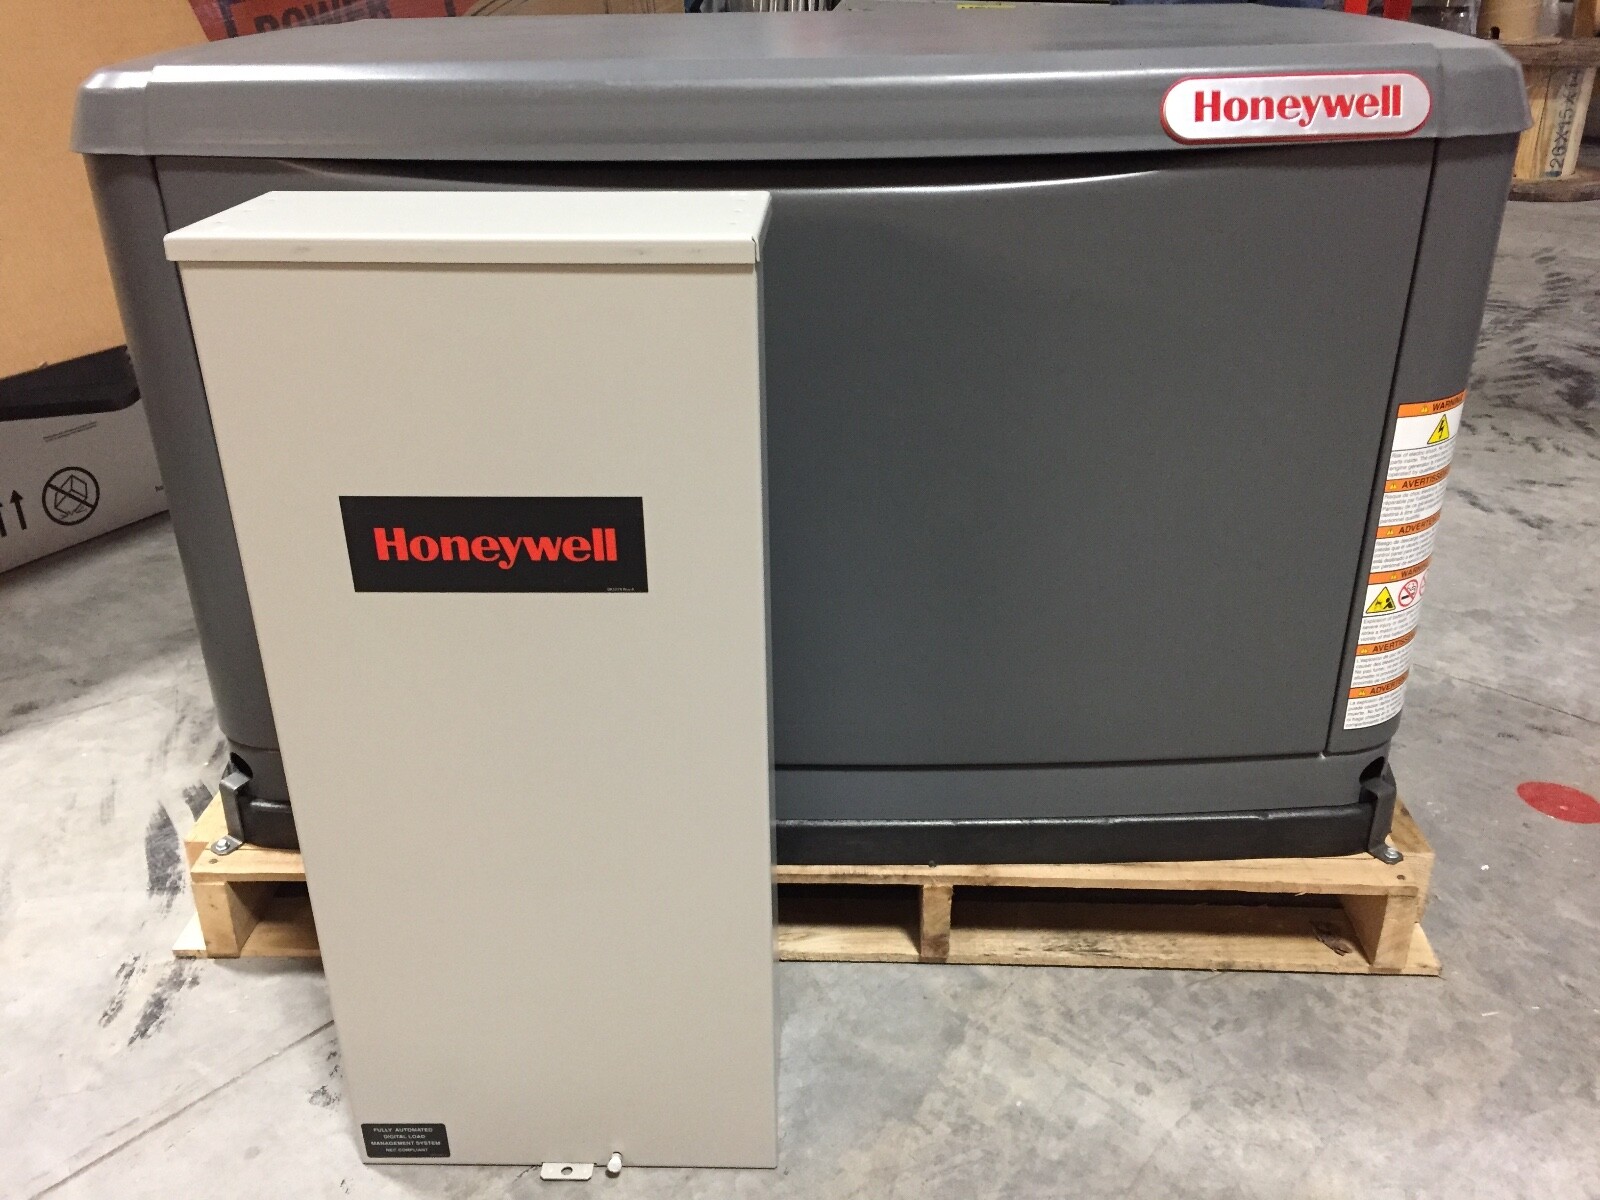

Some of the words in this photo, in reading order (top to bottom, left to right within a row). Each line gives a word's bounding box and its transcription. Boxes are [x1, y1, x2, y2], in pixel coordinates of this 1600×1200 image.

[1194, 84, 1402, 128] Honeywell
[1402, 467, 1449, 489] AVERTISS
[373, 527, 618, 570] Honeywell
